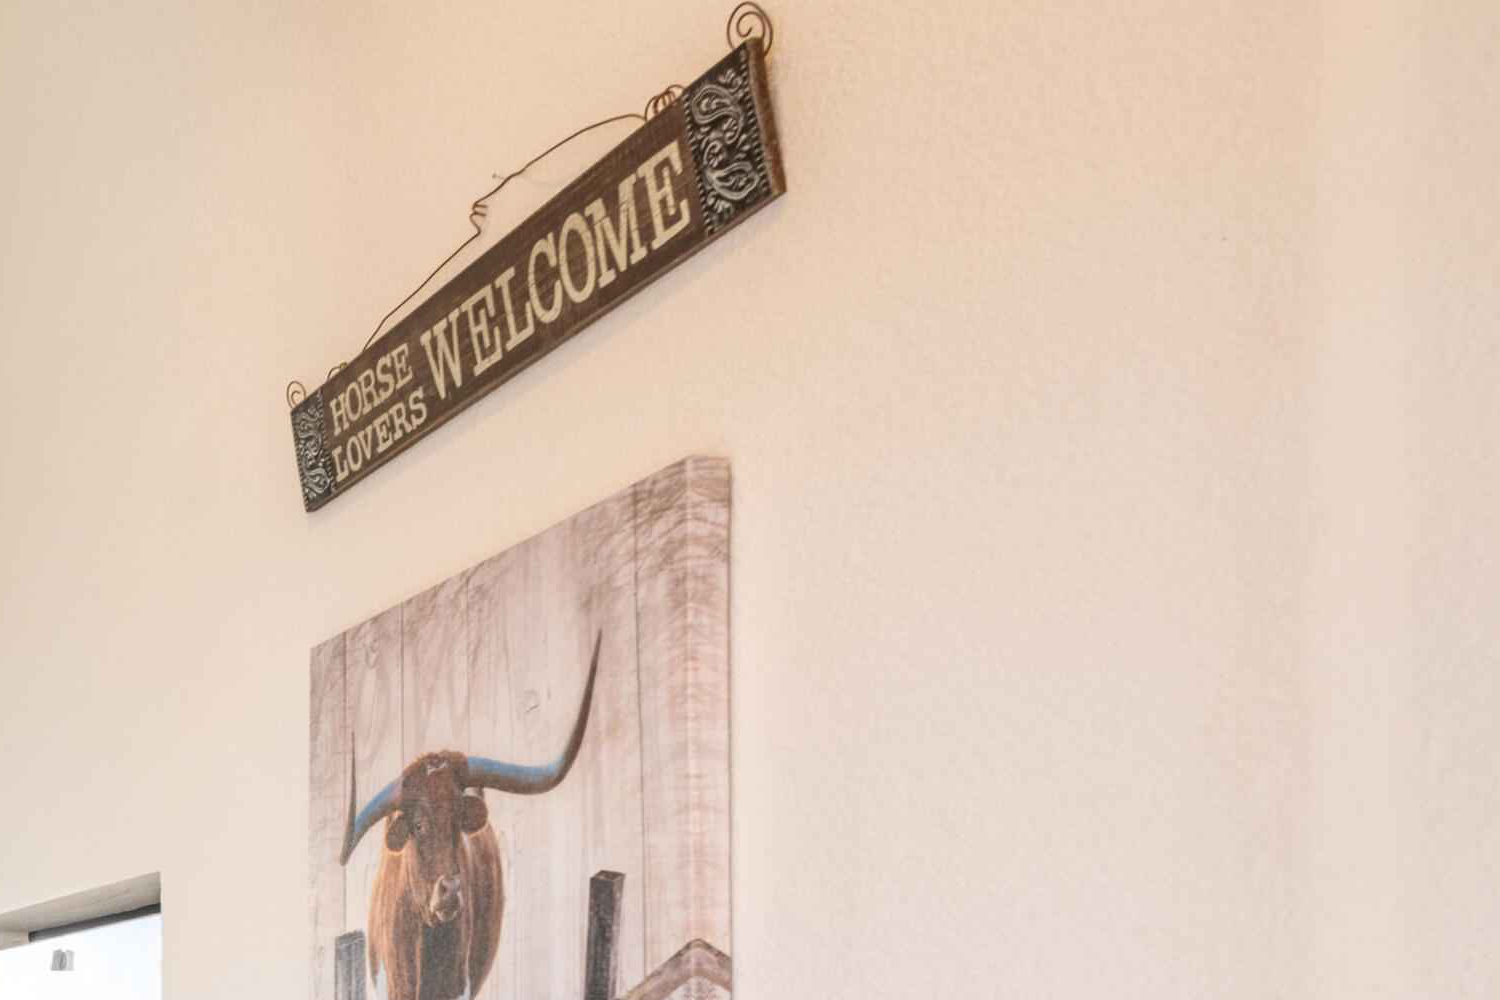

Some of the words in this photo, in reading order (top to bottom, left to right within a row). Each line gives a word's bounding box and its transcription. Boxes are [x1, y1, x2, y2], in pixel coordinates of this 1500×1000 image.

[420, 141, 691, 401] WELCOME
[331, 342, 414, 437] HORSE
[332, 387, 428, 483] LOVERS
